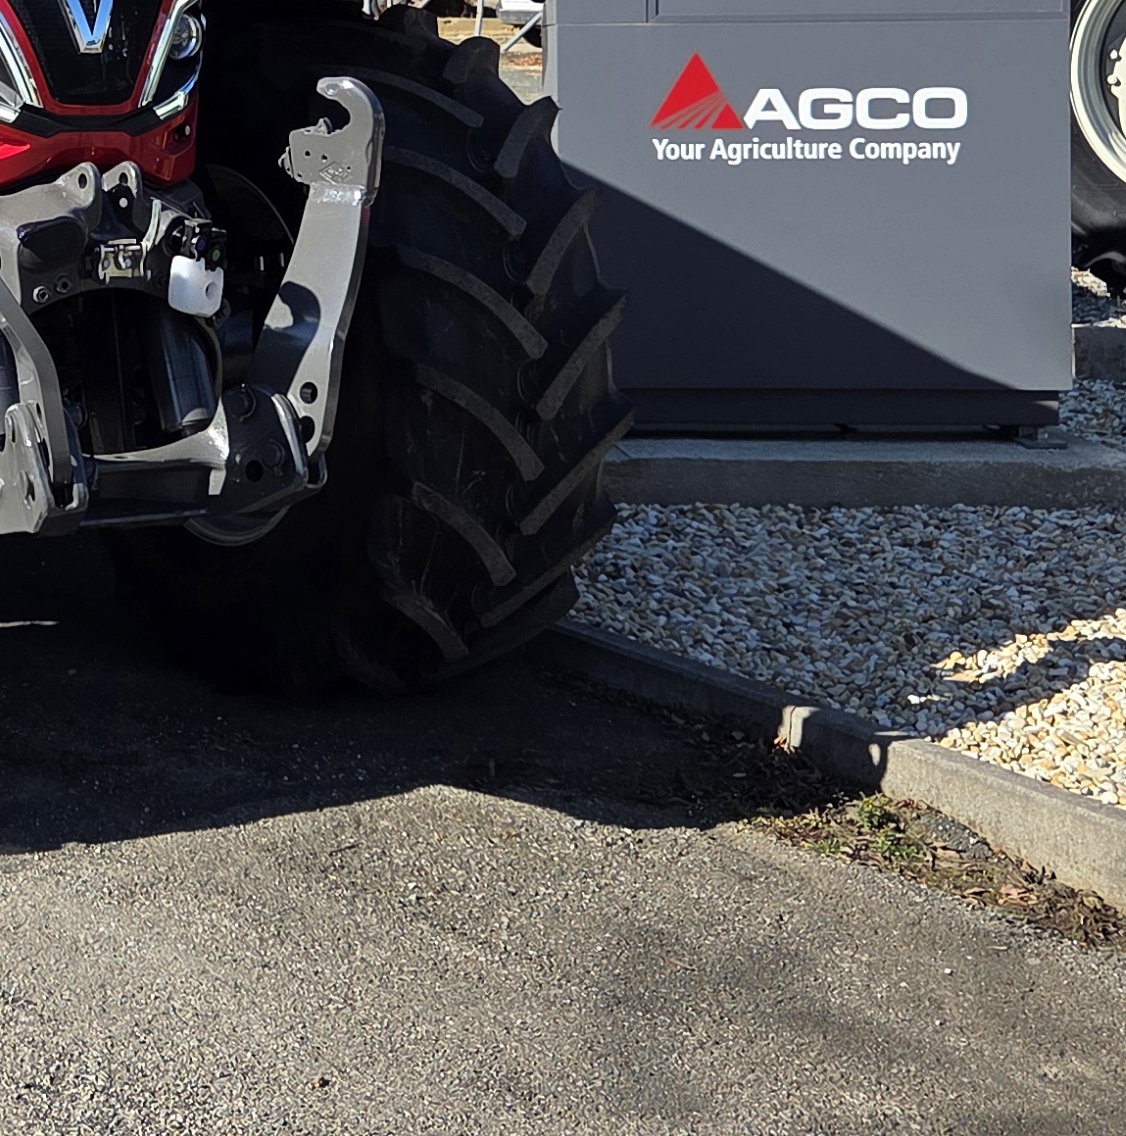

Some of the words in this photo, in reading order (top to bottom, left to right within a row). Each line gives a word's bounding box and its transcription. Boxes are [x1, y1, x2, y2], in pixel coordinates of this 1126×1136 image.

[743, 86, 968, 130] AGCO
[652, 139, 706, 161] Your
[709, 137, 843, 166] Agriculture
[849, 137, 962, 166] Company
